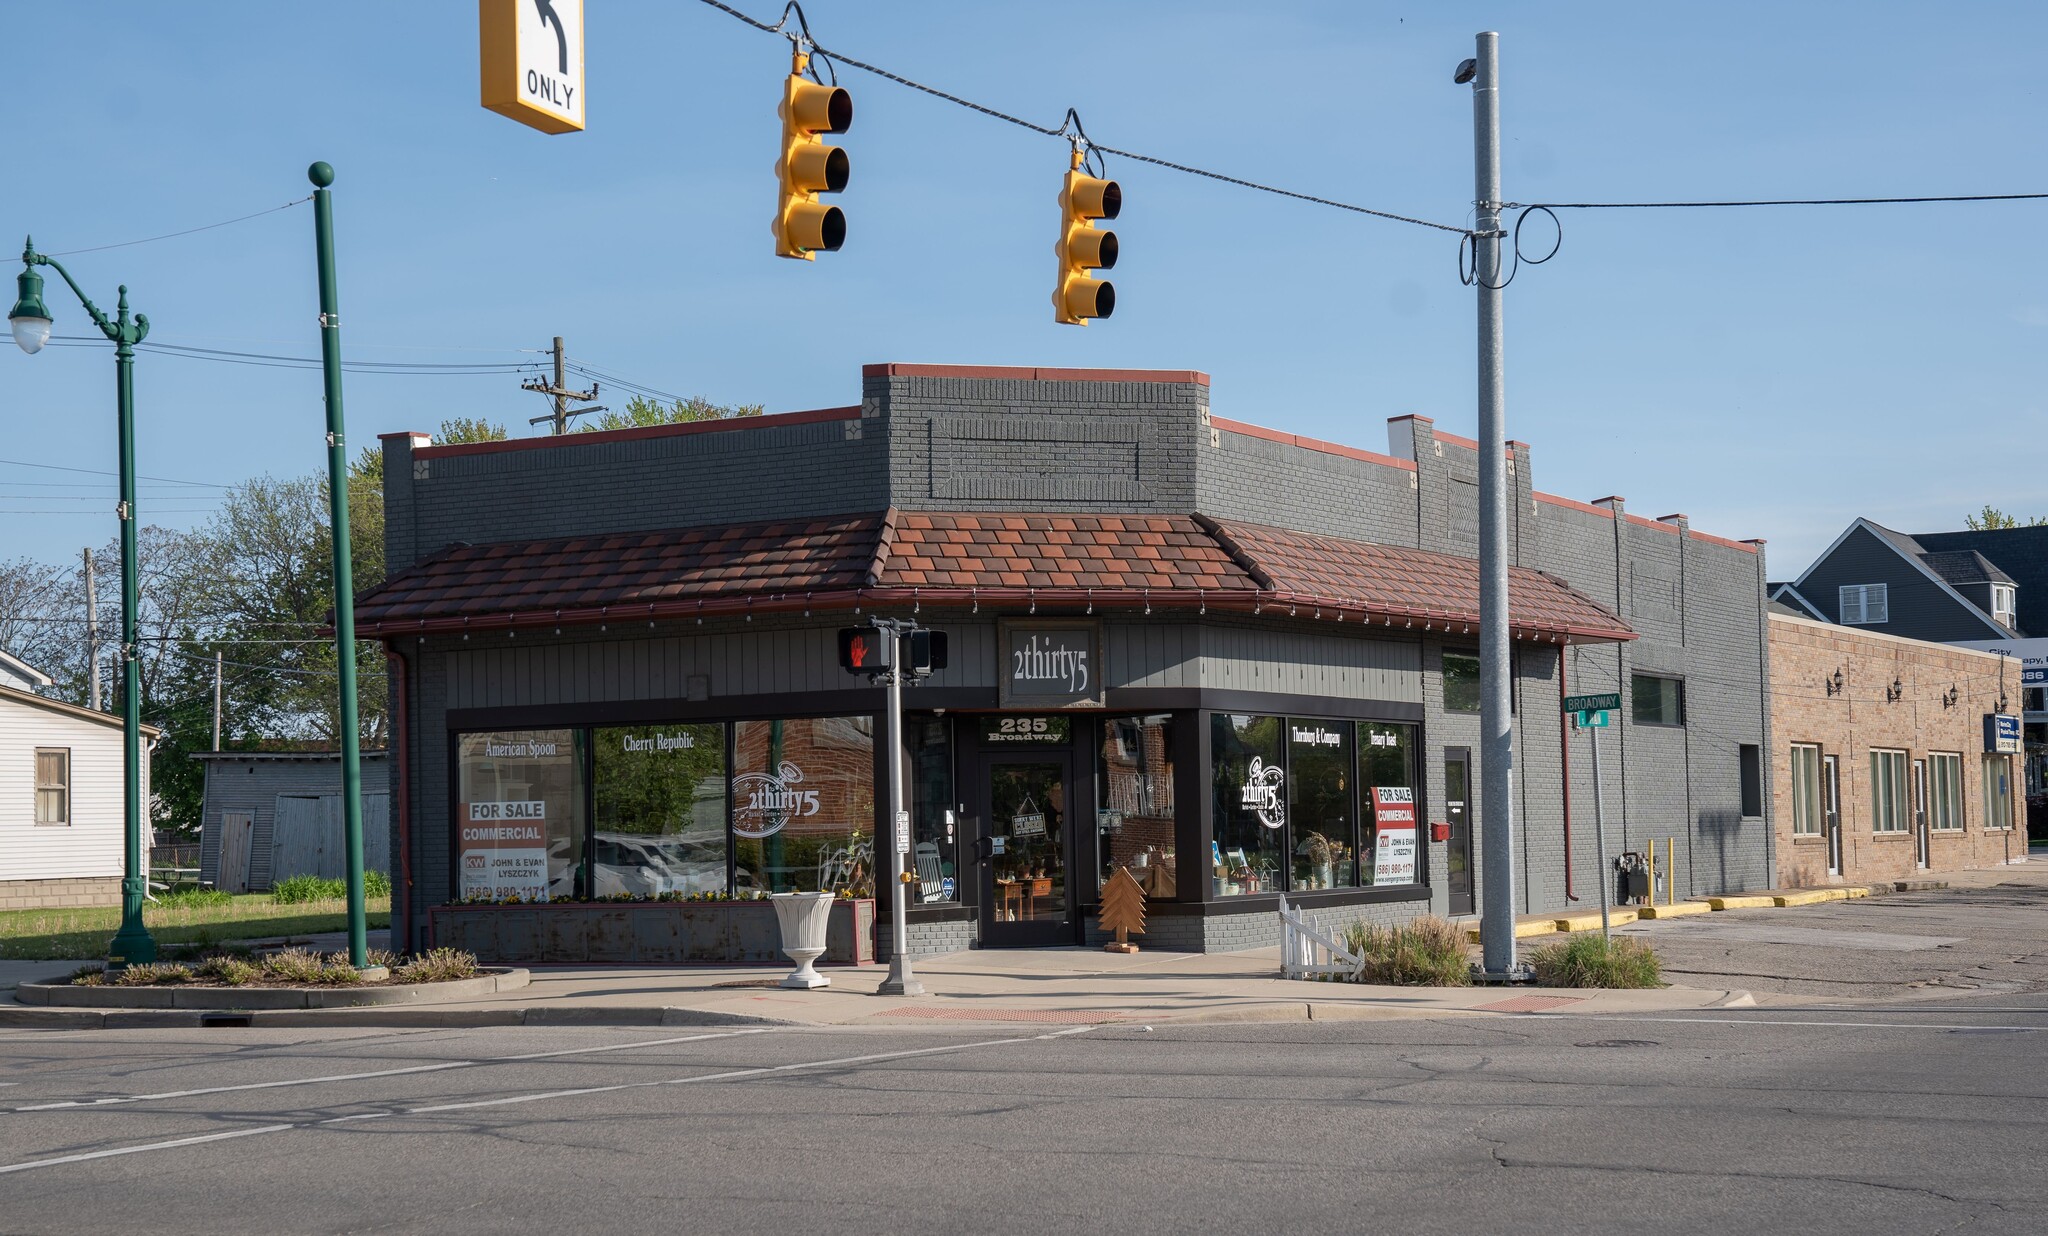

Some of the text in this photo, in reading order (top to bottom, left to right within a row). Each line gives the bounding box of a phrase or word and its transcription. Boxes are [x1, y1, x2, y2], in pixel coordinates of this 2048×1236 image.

[528, 69, 574, 110] ONLY
[1014, 635, 1088, 692] 2thirty5
[1568, 696, 1617, 710] BROADWAY
[1000, 718, 1048, 733] 235
[623, 732, 695, 753] Cherry Republic
[988, 733, 1062, 742] Broadway
[1292, 726, 1340, 748] Thornburg & Company
[1385, 731, 1397, 746] Toast
[486, 739, 556, 759] American Spoon
[749, 783, 820, 817] 2thirty5
[1241, 777, 1276, 810] 2thirty5
[1379, 789, 1412, 801] FOR SALE
[472, 803, 542, 818] FOR SALE
[1378, 810, 1414, 821] COMMERCIAL
[463, 827, 541, 840] COMMERCIAL
[466, 858, 485, 868] KW
[491, 858, 545, 867] JOHN & EVAN
[1377, 863, 1413, 877] (586) 980-1171
[465, 886, 545, 898] (586) 980-1171
